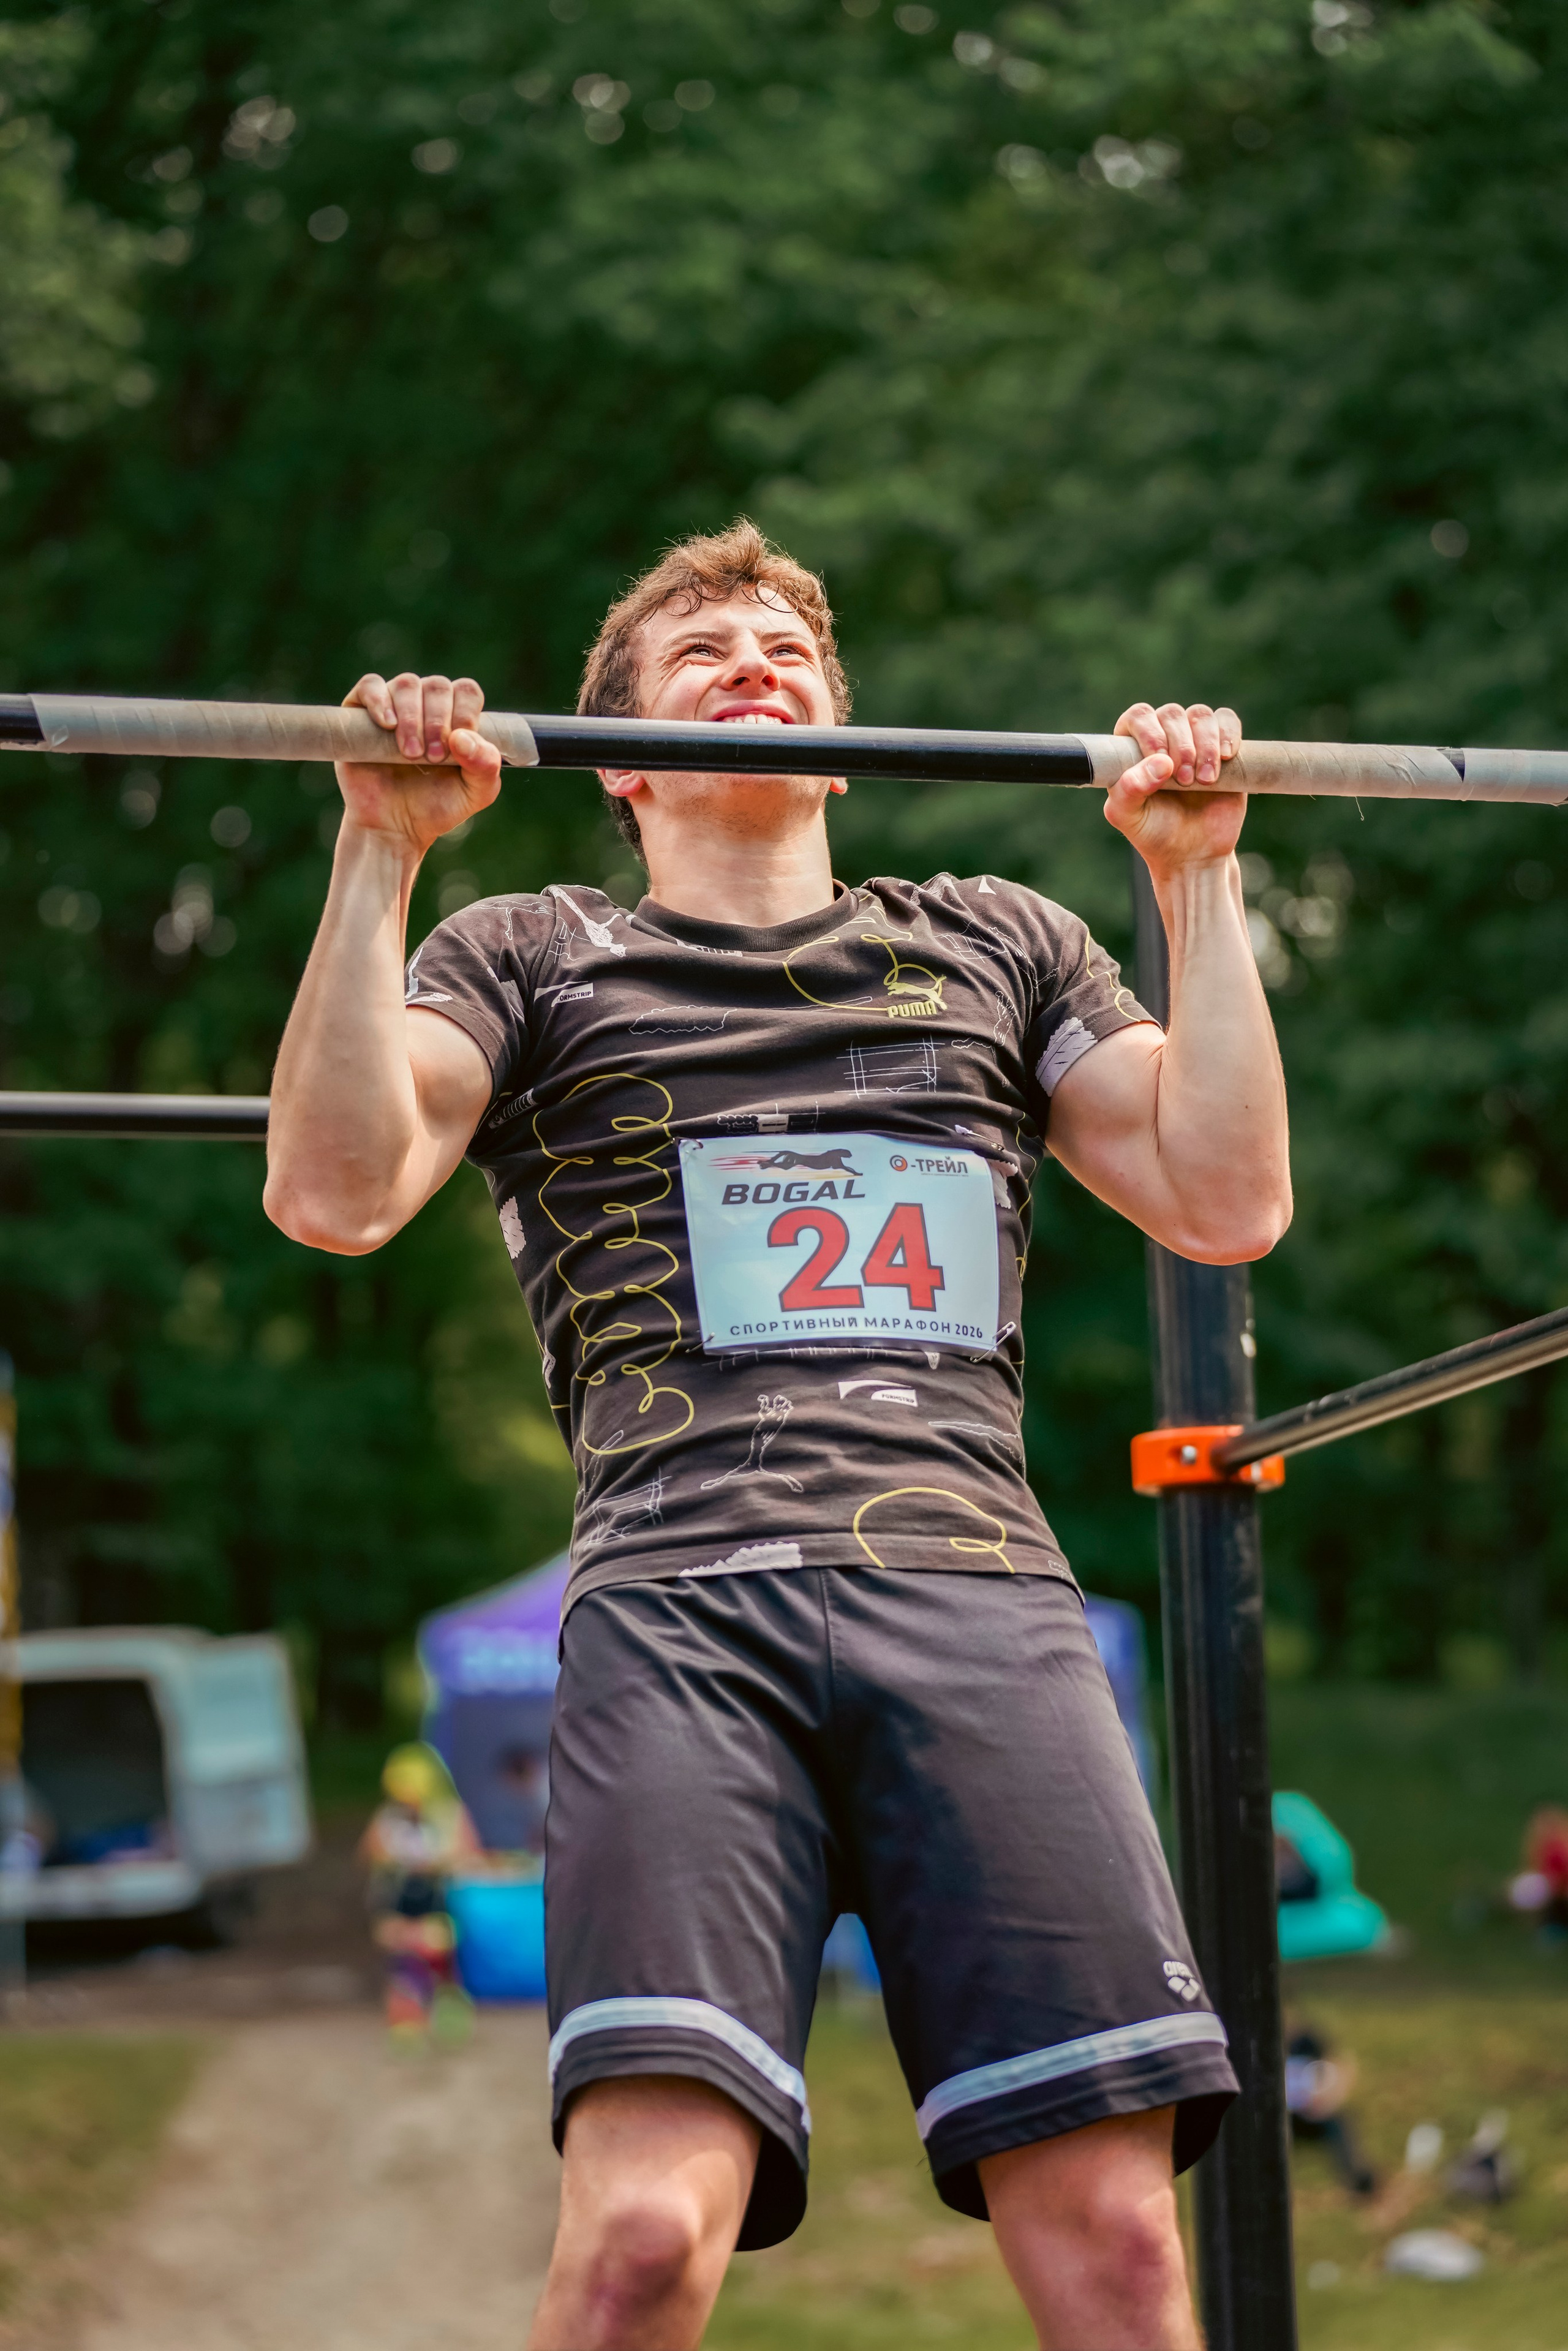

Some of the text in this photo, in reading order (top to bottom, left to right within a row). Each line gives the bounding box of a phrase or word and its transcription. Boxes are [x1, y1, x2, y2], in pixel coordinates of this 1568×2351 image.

[887, 1000, 937, 1018] PUMA
[722, 1179, 865, 1205] BOGAL
[767, 1202, 945, 1312] 24
[730, 1316, 983, 1338] СПОРТИВНЫЙ МАРАФОН 2026
